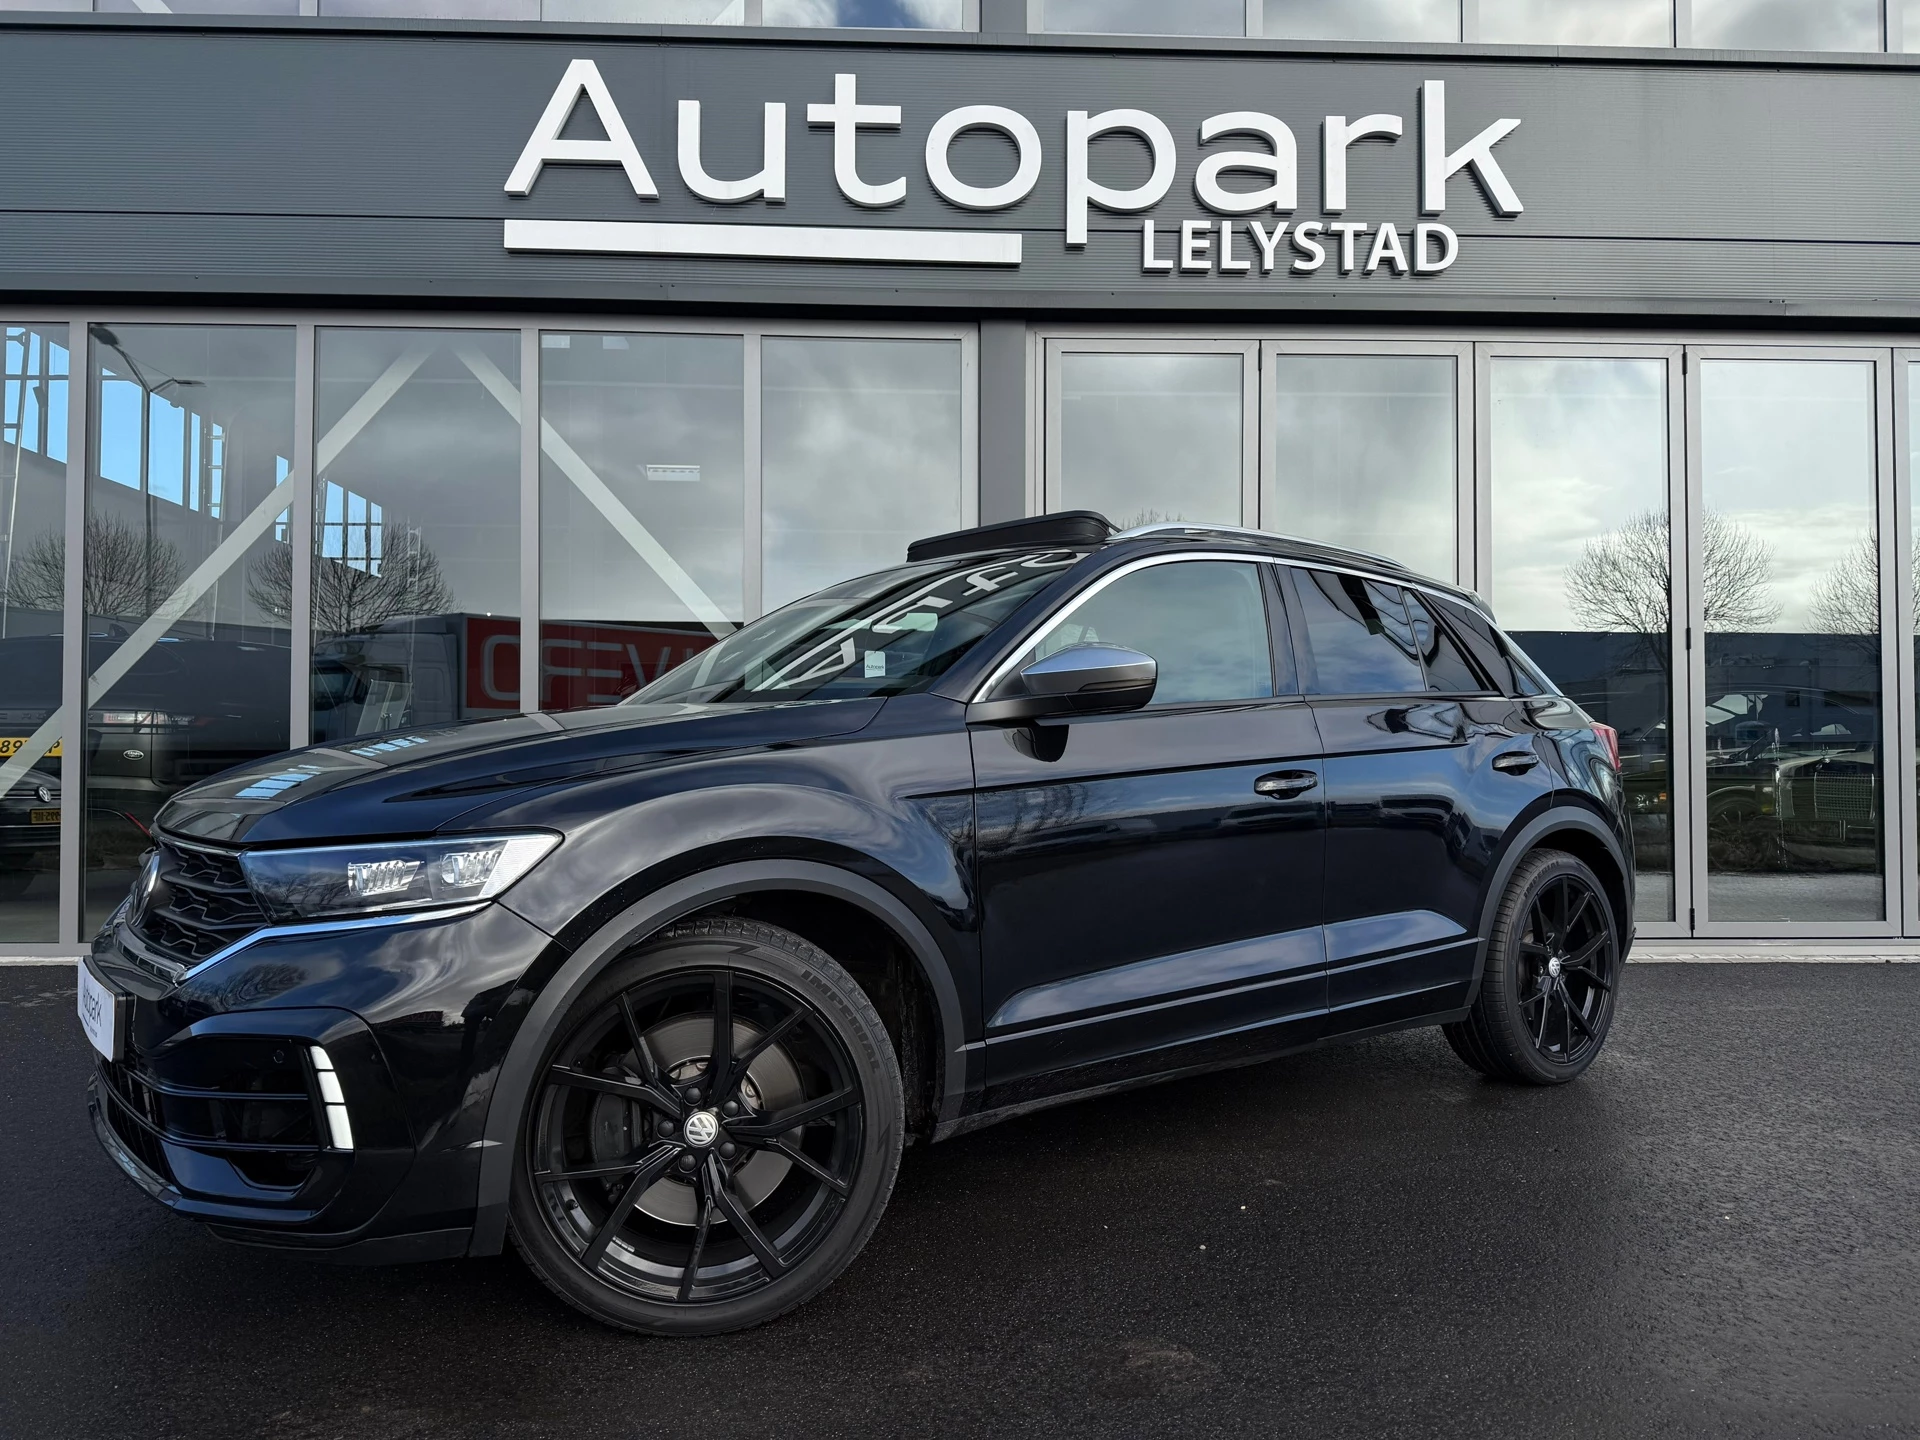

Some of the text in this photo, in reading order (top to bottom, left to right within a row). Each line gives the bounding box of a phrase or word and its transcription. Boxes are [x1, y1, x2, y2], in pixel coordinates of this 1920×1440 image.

[504, 58, 1524, 247] Autopark
[1141, 218, 1459, 276] LELYSTAD
[800, 969, 881, 1074] IMPERIAL
